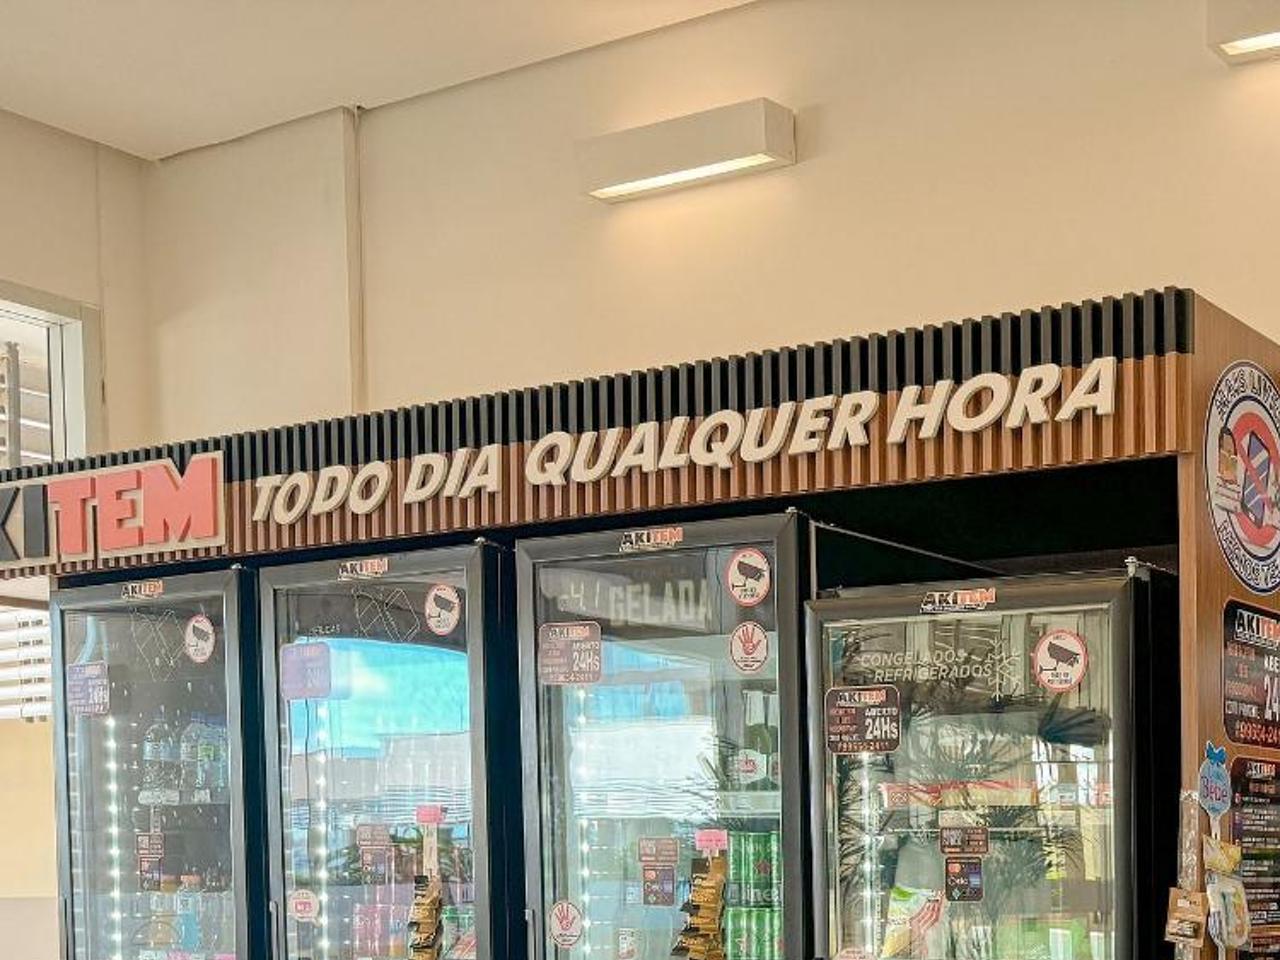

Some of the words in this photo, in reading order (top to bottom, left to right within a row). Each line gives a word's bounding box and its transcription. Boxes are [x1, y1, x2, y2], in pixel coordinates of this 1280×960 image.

[252, 460, 392, 525] TODO
[402, 443, 500, 504] DIA
[525, 391, 879, 485] QUALQUER
[887, 357, 1117, 444] HORA
[859, 650, 965, 666] CONGELADOS
[874, 664, 993, 682] REFRIGERADOS
